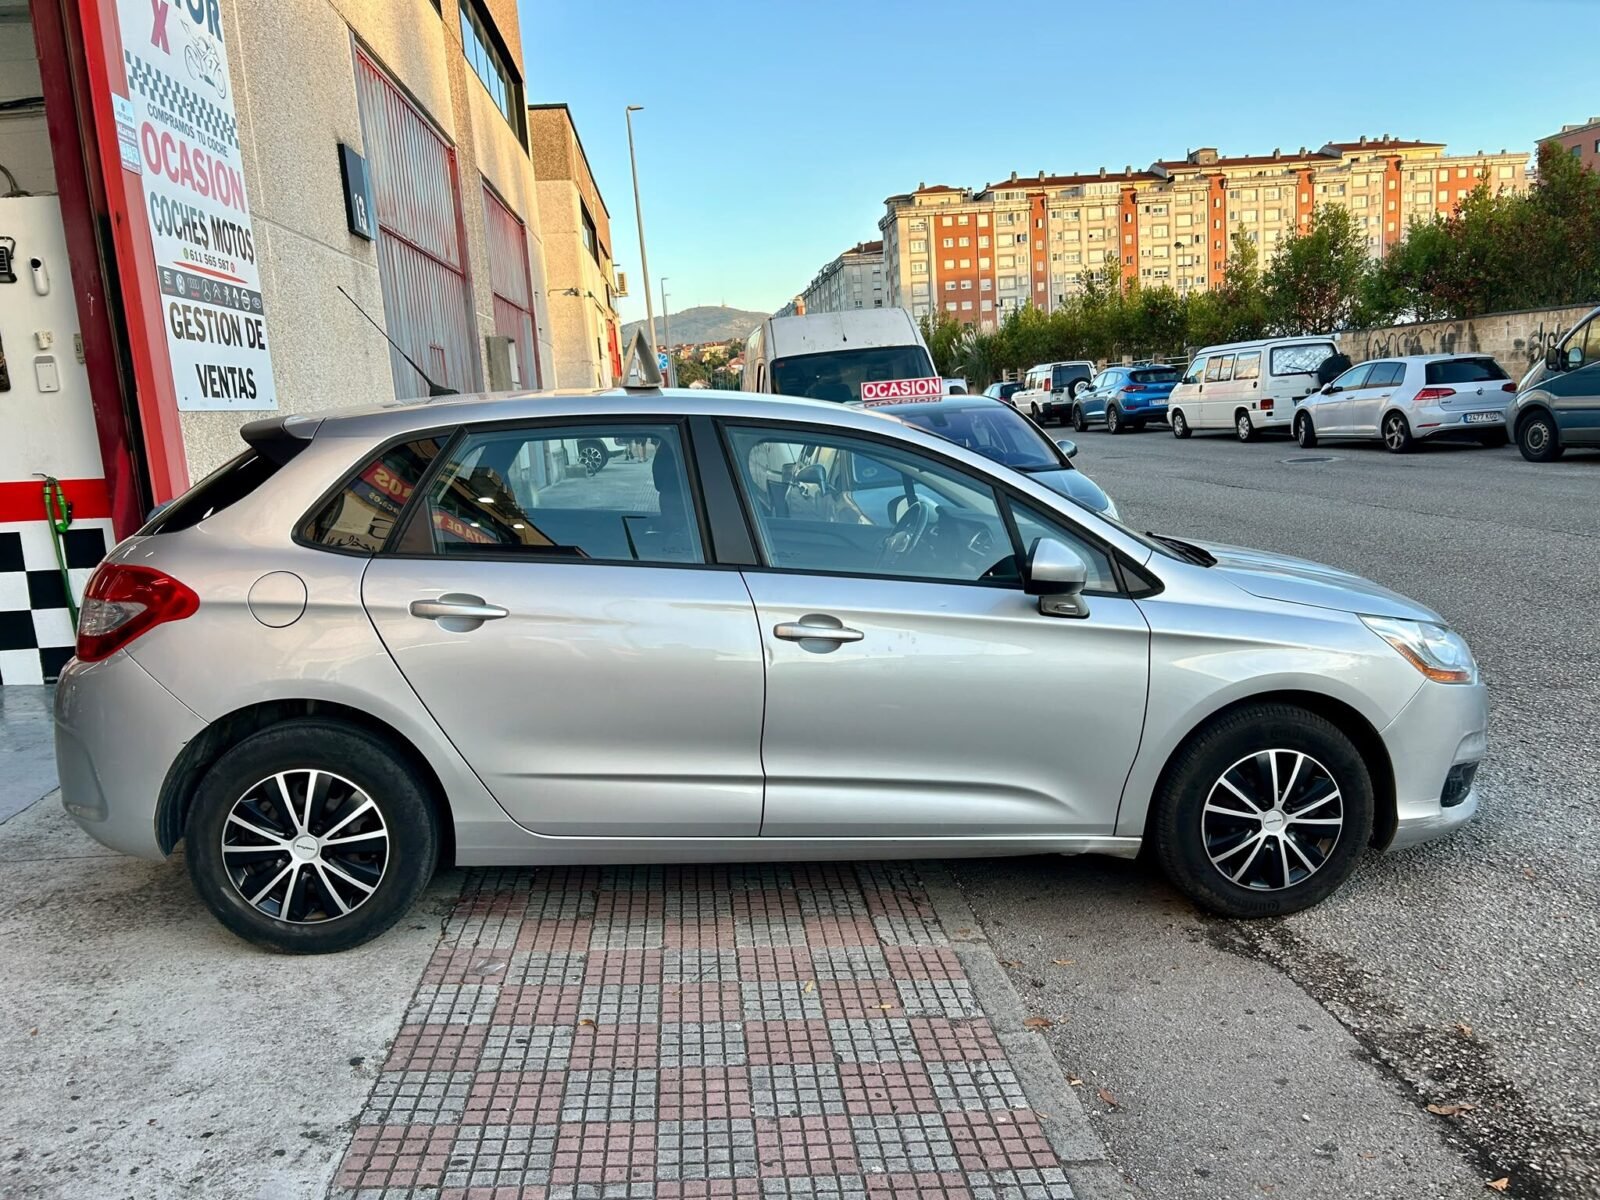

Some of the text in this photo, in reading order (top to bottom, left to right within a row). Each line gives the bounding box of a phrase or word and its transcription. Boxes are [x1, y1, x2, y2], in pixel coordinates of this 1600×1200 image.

[151, 0, 171, 55] X
[147, 103, 195, 138] COMPRAMOS
[196, 130, 207, 145] TU
[207, 138, 228, 158] COCHE
[141, 121, 246, 214] OCASION
[150, 191, 255, 265] COCHES MOTOS
[354, 193, 367, 231] 13
[190, 249, 203, 264] 611
[204, 254, 217, 267] 565
[170, 301, 266, 351] GESTION DE
[195, 363, 257, 400] VENTAS
[864, 379, 940, 398] OCASION
